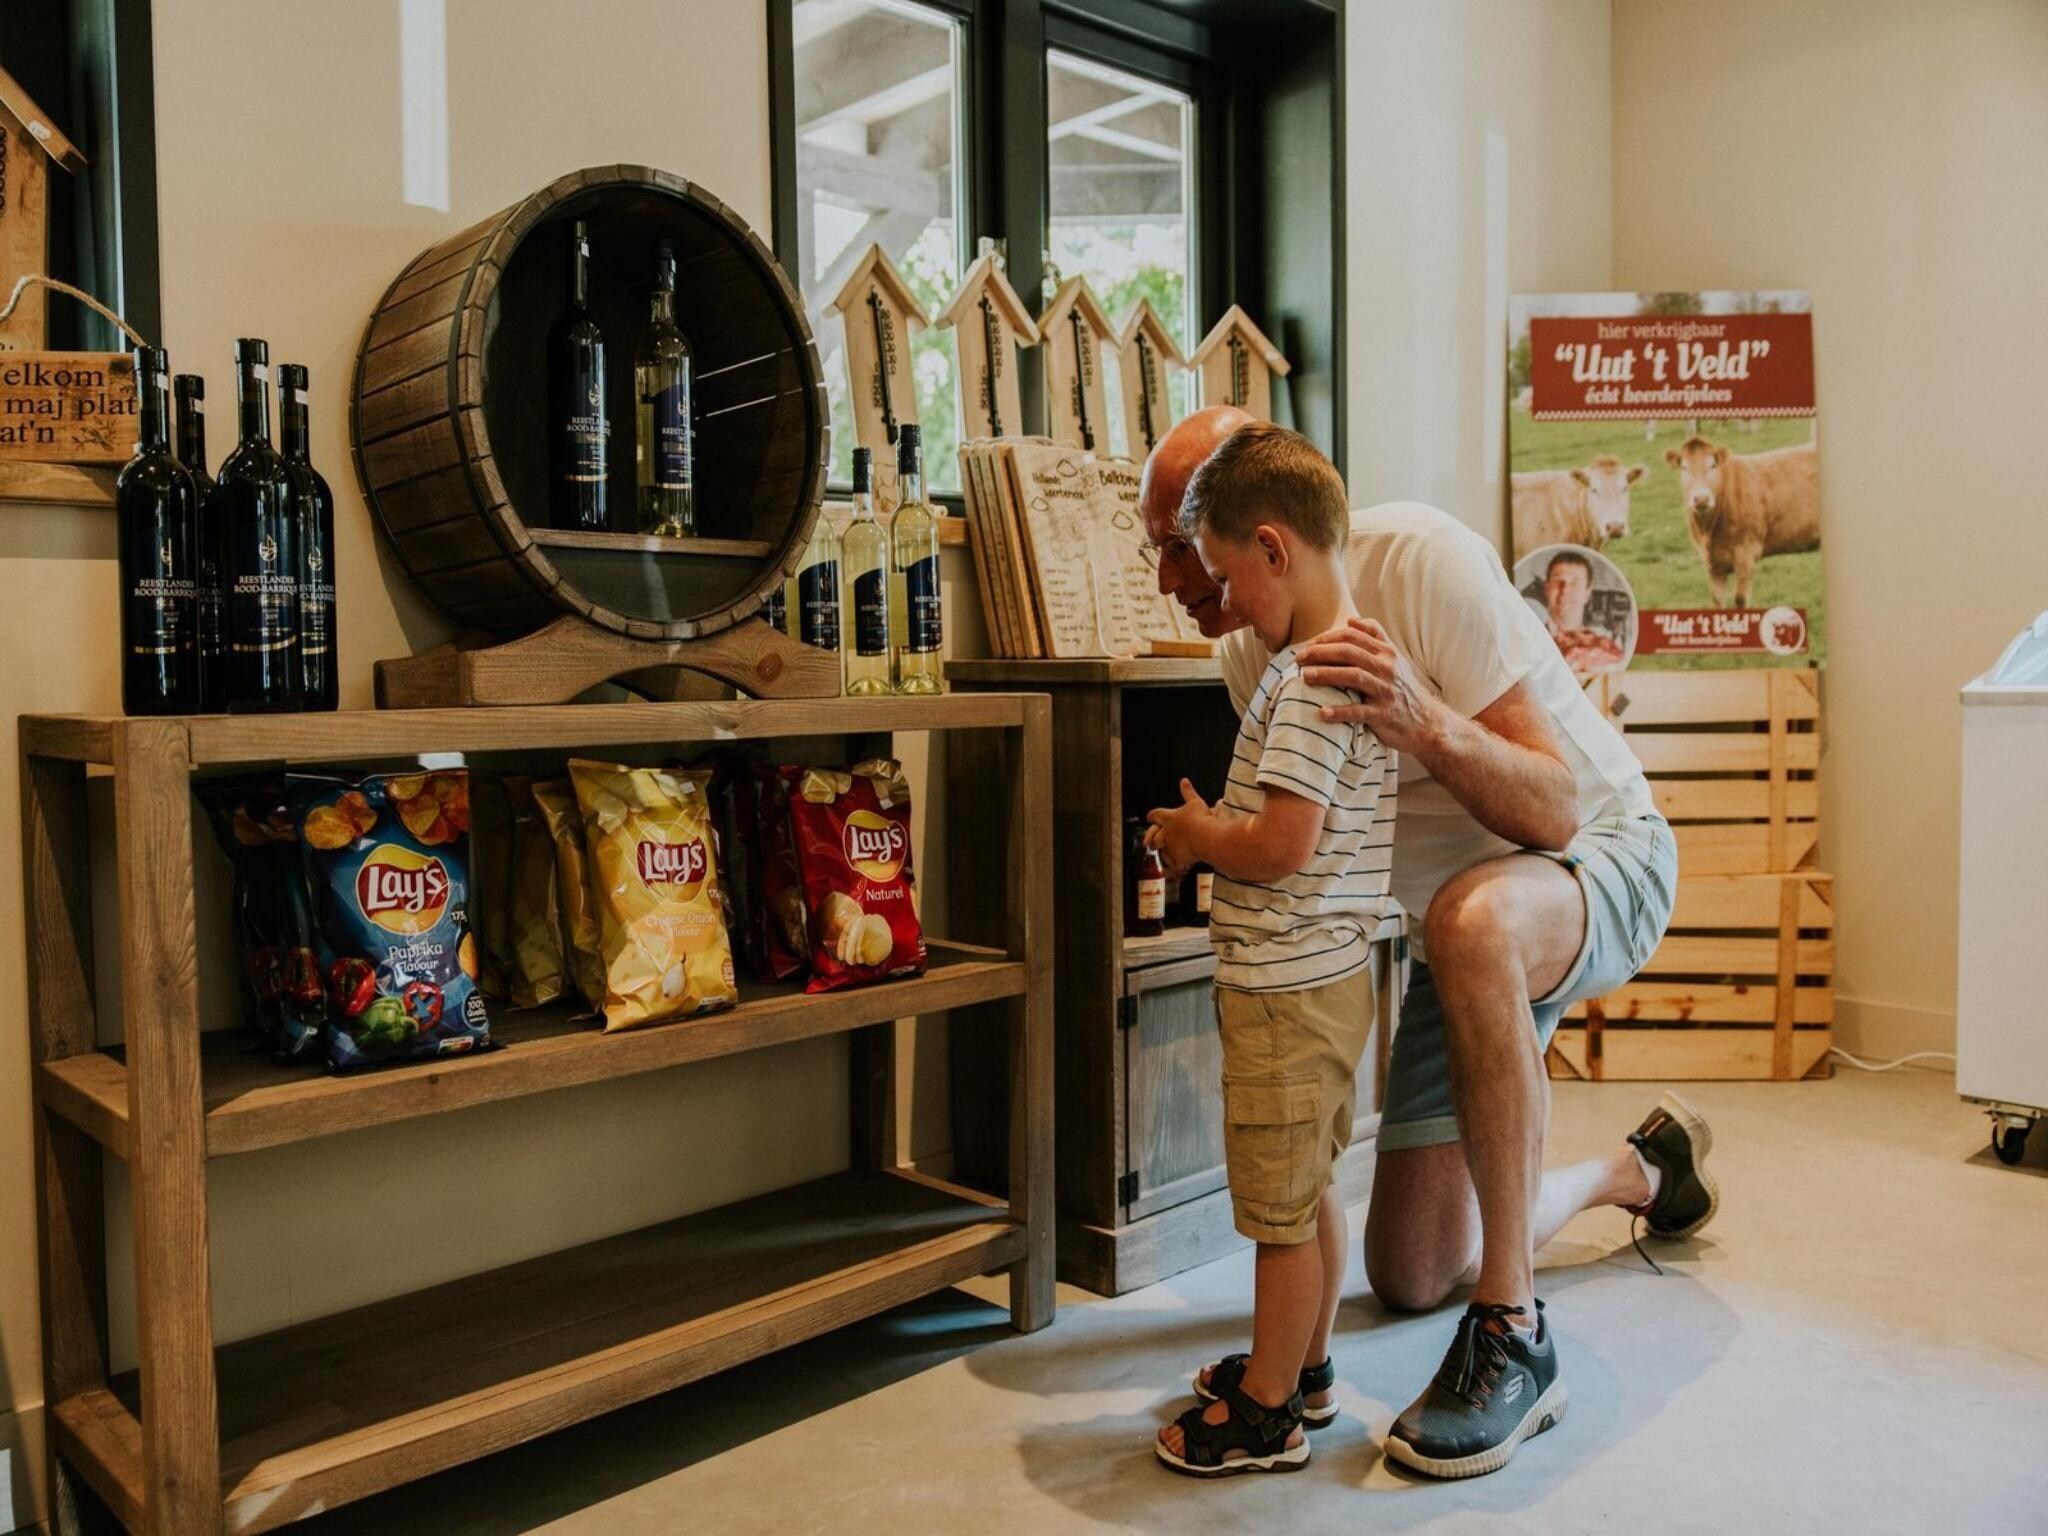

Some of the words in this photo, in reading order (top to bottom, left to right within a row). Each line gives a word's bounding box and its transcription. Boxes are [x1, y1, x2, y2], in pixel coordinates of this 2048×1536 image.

[1598, 322, 1629, 339] hier
[1633, 322, 1727, 340] verkrijgbaar
[0, 362, 104, 387] elkom
[6, 392, 63, 420] maj
[0, 420, 55, 443] at'n
[850, 825, 903, 864] Lay's
[644, 841, 704, 886] Lay's
[367, 863, 443, 914] Lay's
[865, 885, 904, 901] Naturel
[388, 943, 444, 961] Paprika
